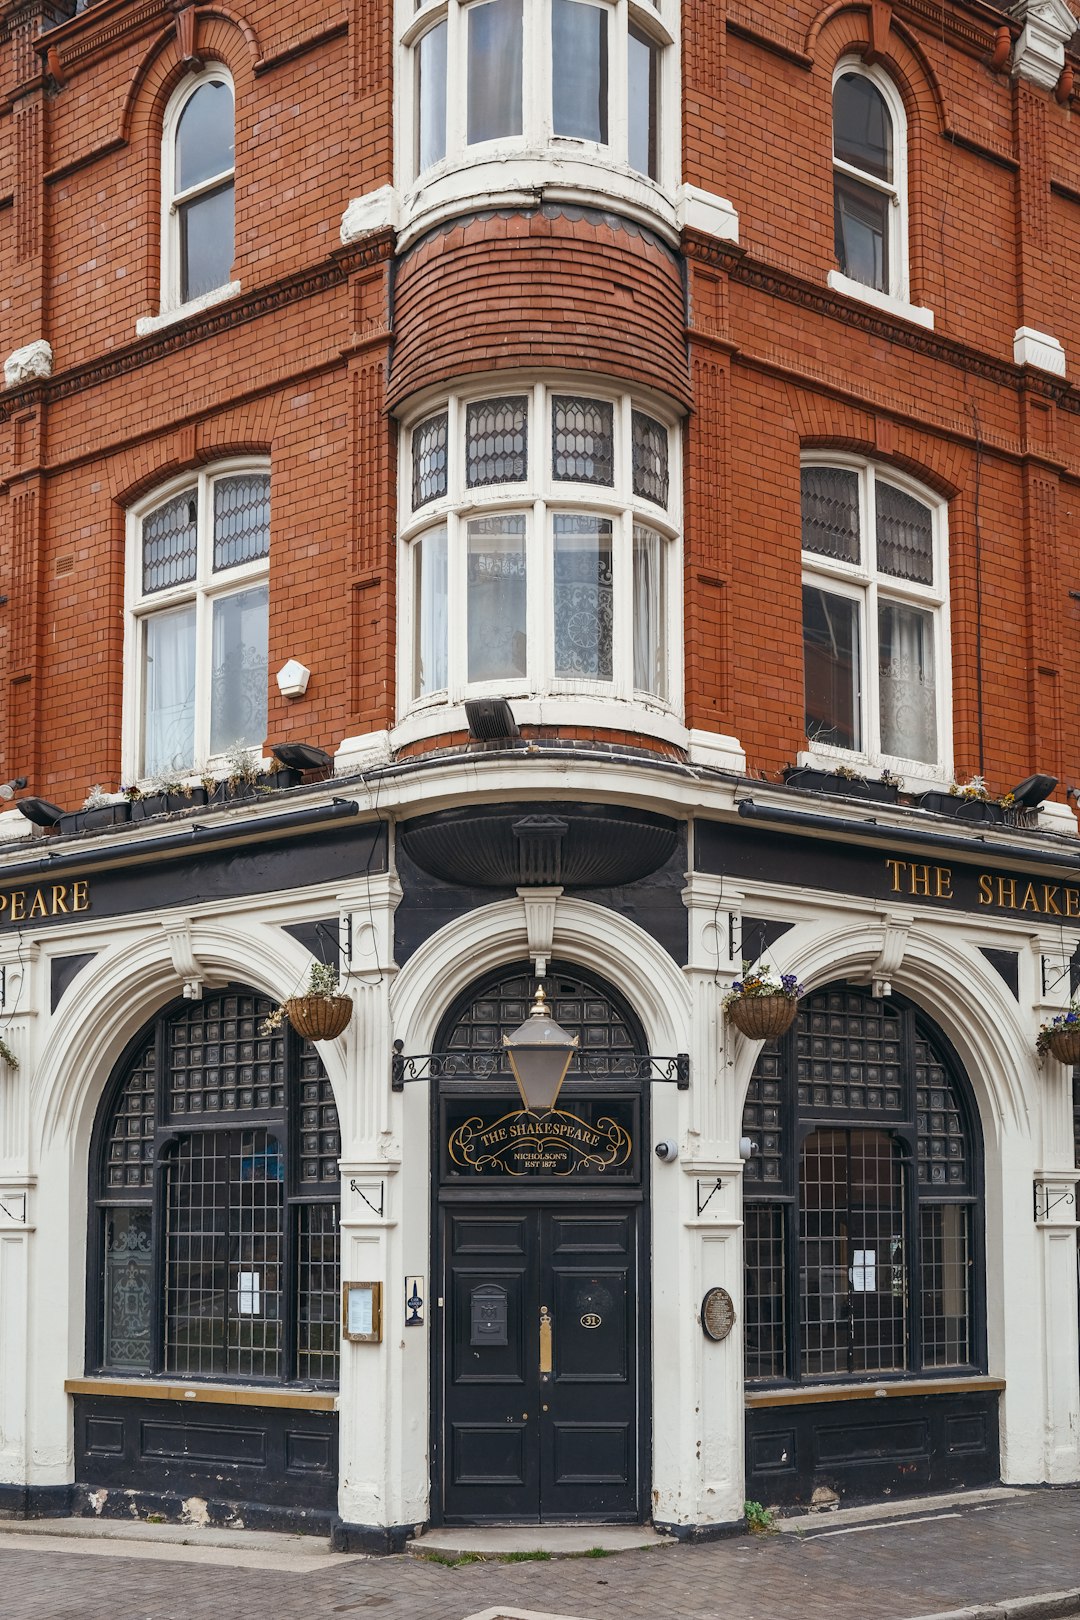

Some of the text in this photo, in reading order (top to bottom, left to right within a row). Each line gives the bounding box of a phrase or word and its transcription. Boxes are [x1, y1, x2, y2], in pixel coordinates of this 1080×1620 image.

[885, 859, 1080, 918] THE SHAKE
[481, 1122, 600, 1147] THE SHAKESPEARE
[513, 1152, 568, 1161] NICHOLSON'S
[524, 1160, 540, 1168] EST
[585, 1316, 597, 1325] 31
